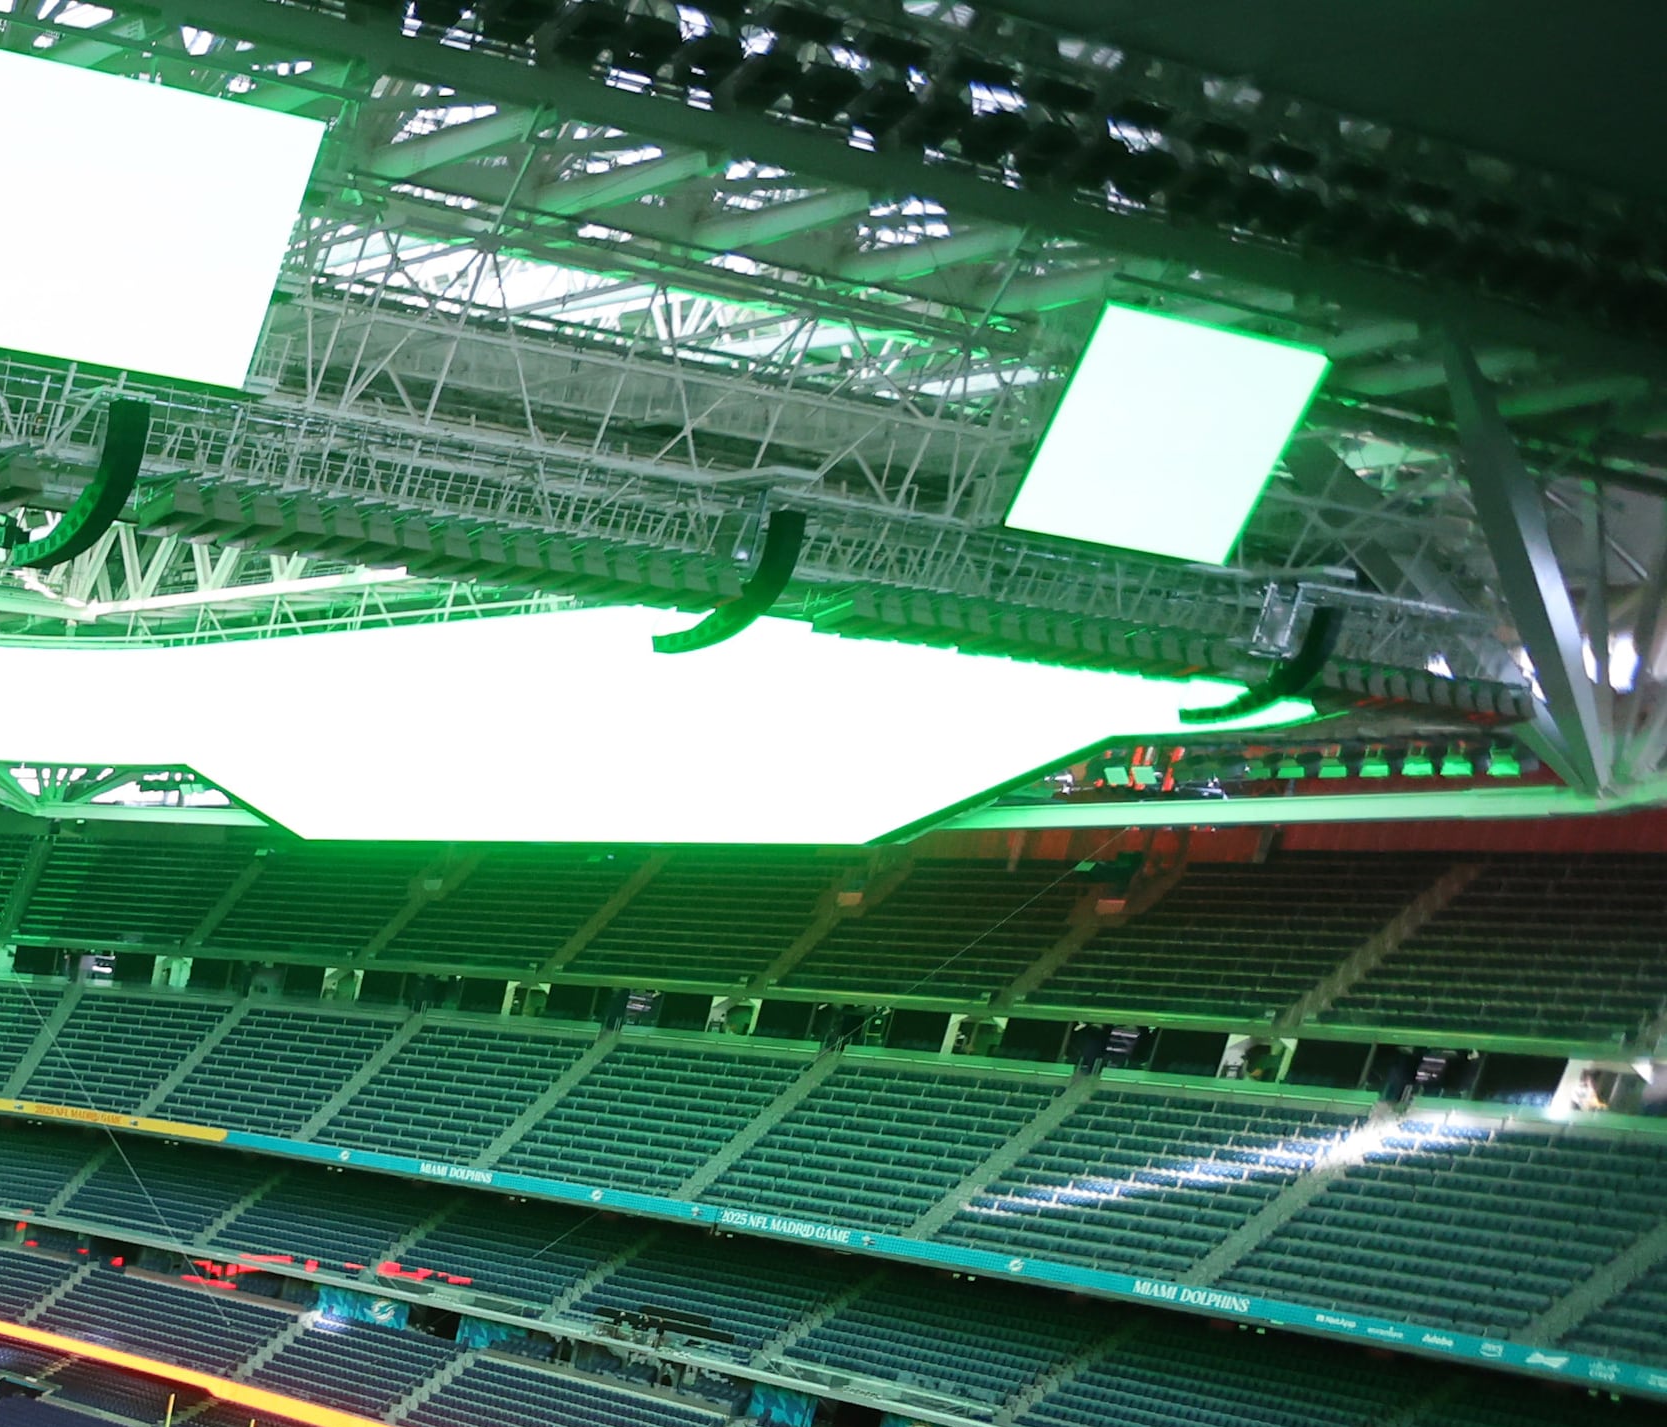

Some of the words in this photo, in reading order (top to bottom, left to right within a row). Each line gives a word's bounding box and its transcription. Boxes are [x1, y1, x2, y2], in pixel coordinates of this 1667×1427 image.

[419, 1162, 448, 1176] MIAMI
[448, 1167, 493, 1184] DOLPHINS
[720, 1211, 748, 1225] 2025
[748, 1215, 768, 1229] NFL
[770, 1218, 815, 1238] MADRID
[815, 1226, 851, 1243] GAME
[1133, 1280, 1177, 1300] MIAMI
[1179, 1287, 1250, 1313] DOLPHINS
